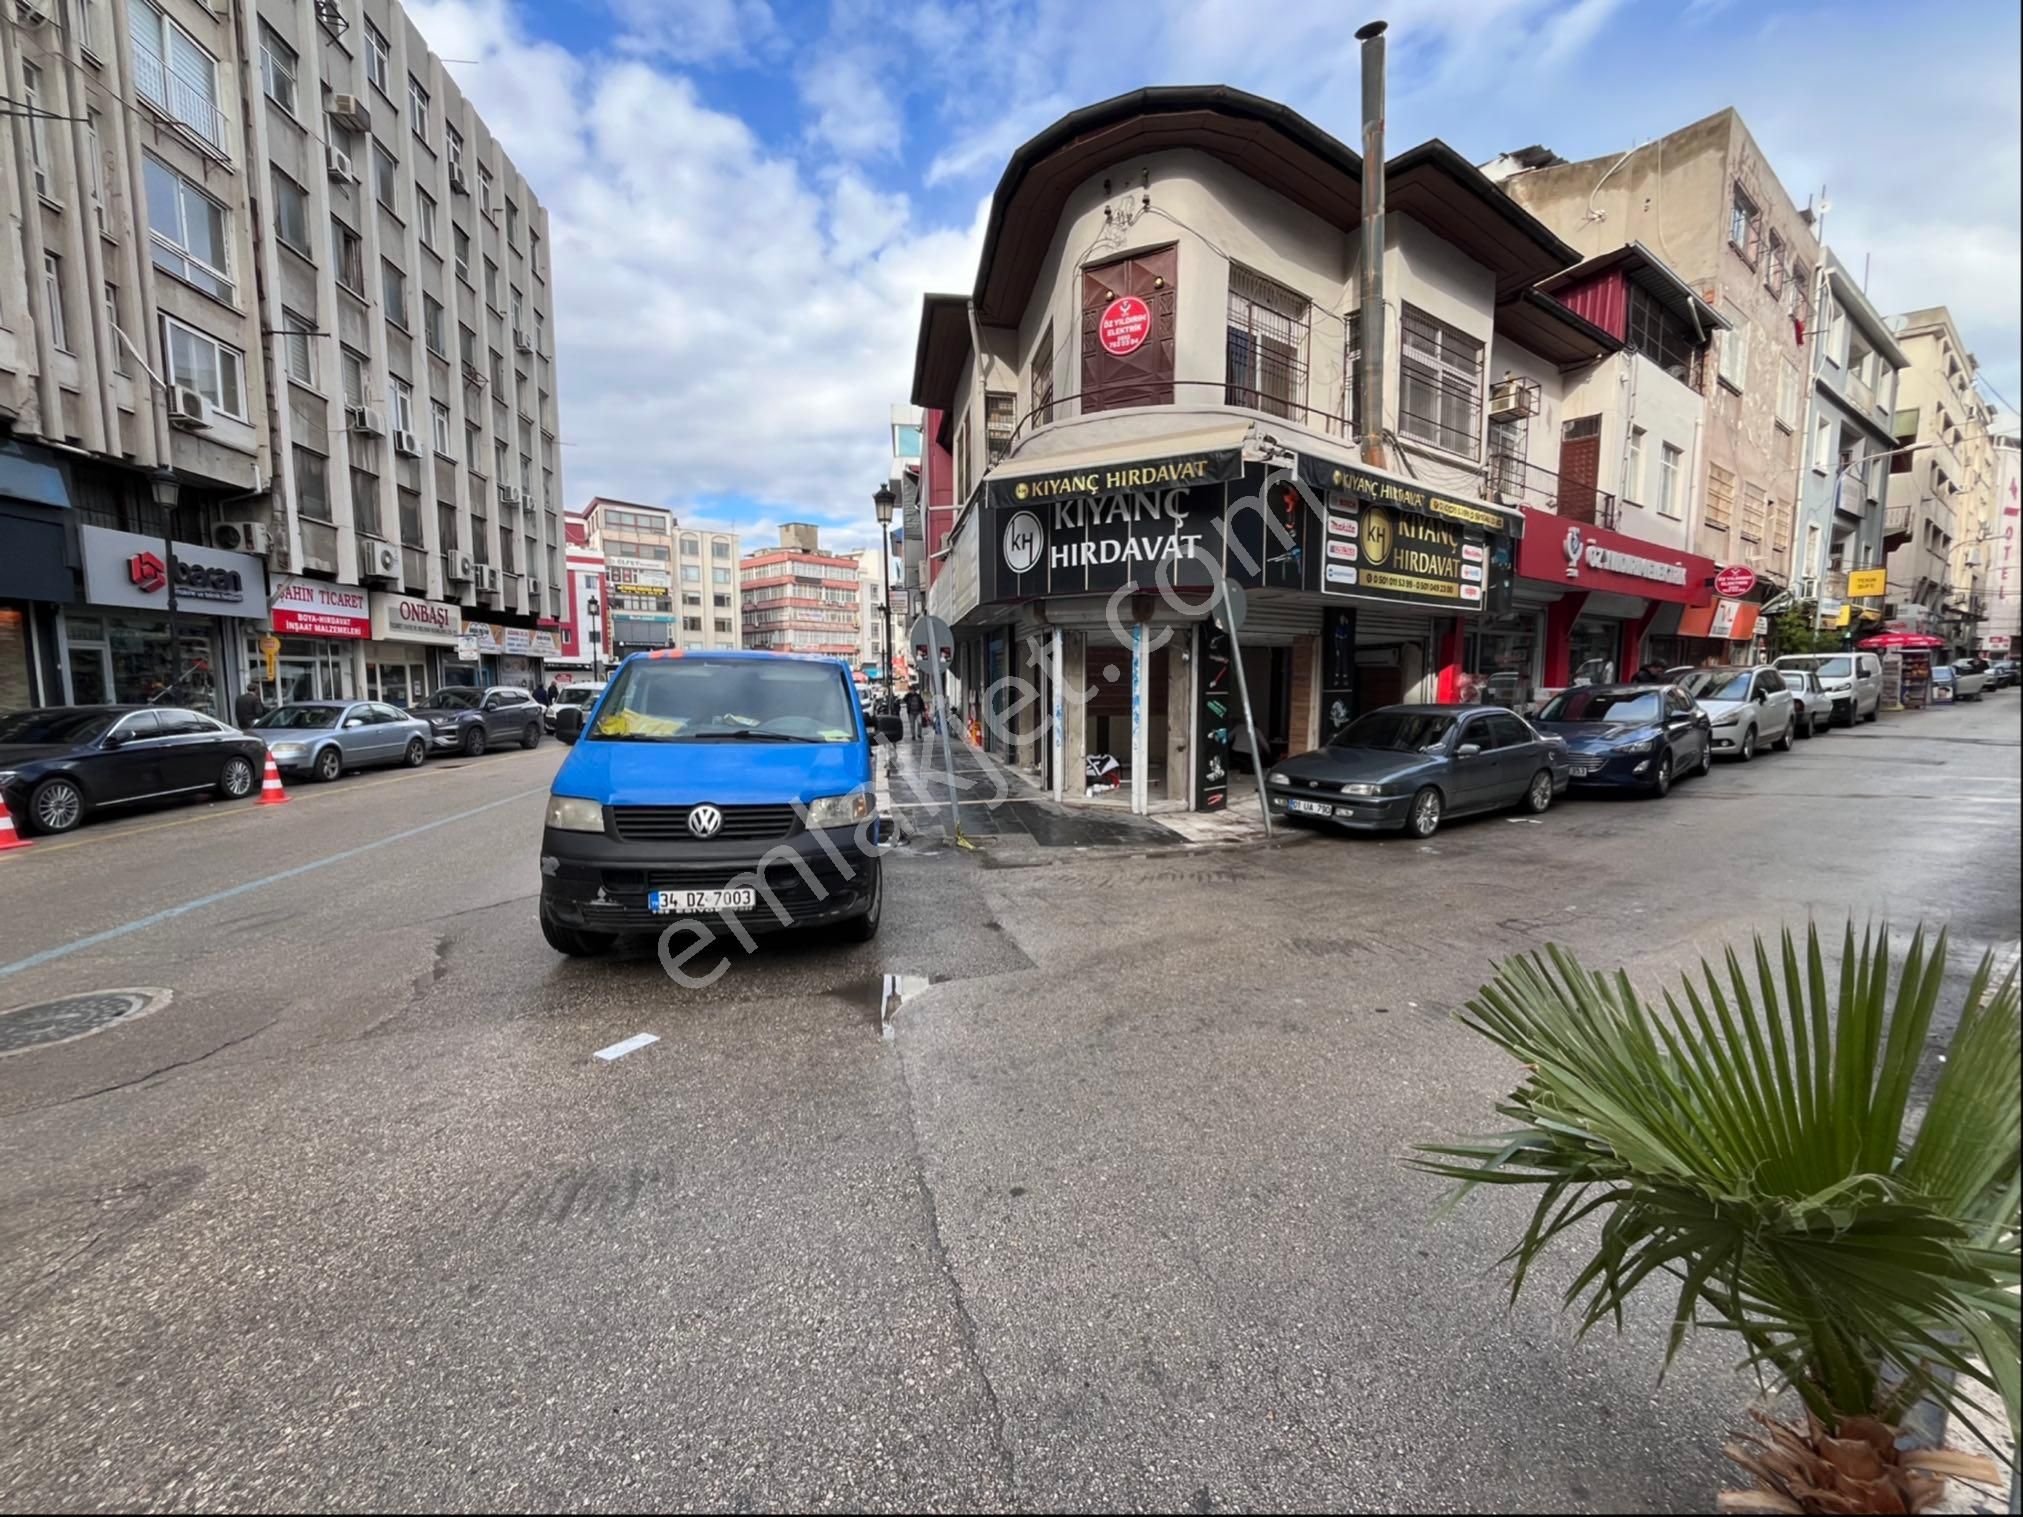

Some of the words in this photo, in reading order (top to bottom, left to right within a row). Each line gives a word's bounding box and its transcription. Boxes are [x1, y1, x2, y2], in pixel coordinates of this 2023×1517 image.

[1032, 474, 1099, 497] KIYANÇ
[1106, 460, 1208, 489] HIRDAVAT
[1054, 488, 1191, 530] KIYANÇ
[1051, 534, 1203, 569] HIRDAVAT
[1394, 547, 1461, 579] HIRDAVAT
[400, 601, 449, 628] ONBAŞI
[660, 892, 678, 908] 34
[687, 892, 705, 907] DZ
[713, 890, 751, 906] 7003
